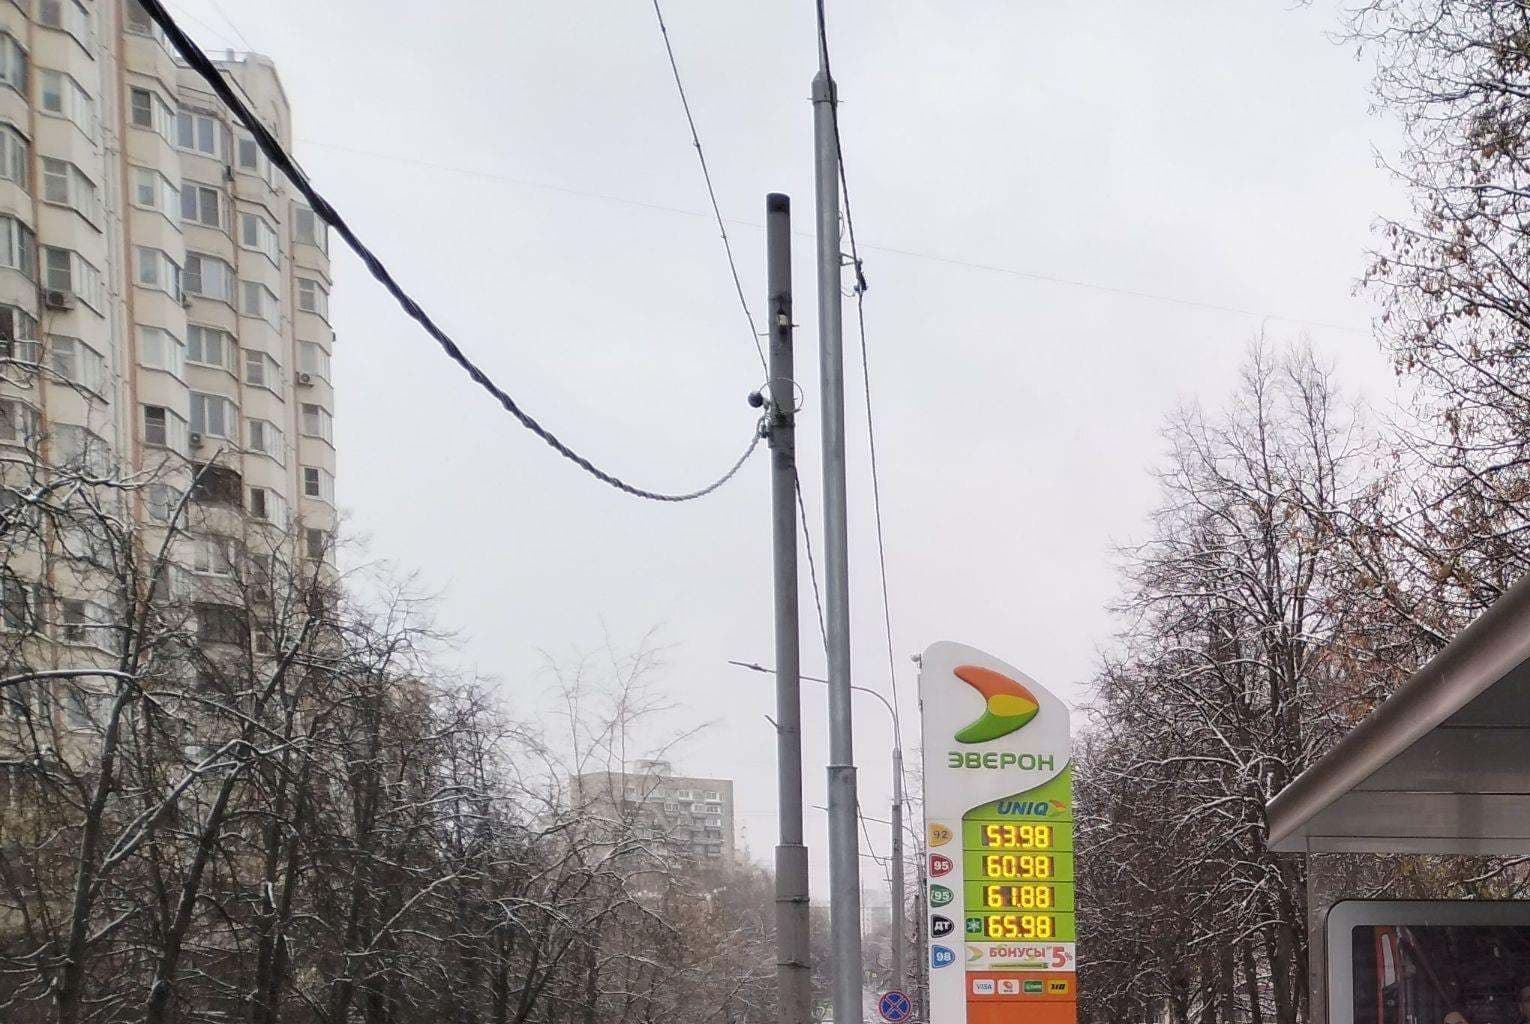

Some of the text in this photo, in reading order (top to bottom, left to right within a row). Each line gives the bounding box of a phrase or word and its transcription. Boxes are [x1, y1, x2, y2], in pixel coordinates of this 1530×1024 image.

[948, 752, 1054, 771] ЭВЕРОН
[997, 801, 1049, 817] UNIQ
[933, 824, 1049, 848] 92 53.98
[933, 855, 1049, 878] 95 60.98
[987, 885, 1050, 908] 61.88
[934, 915, 1051, 939] ДТ 65.98
[936, 951, 951, 962] 98
[989, 946, 1046, 958] БОНУСЫ
